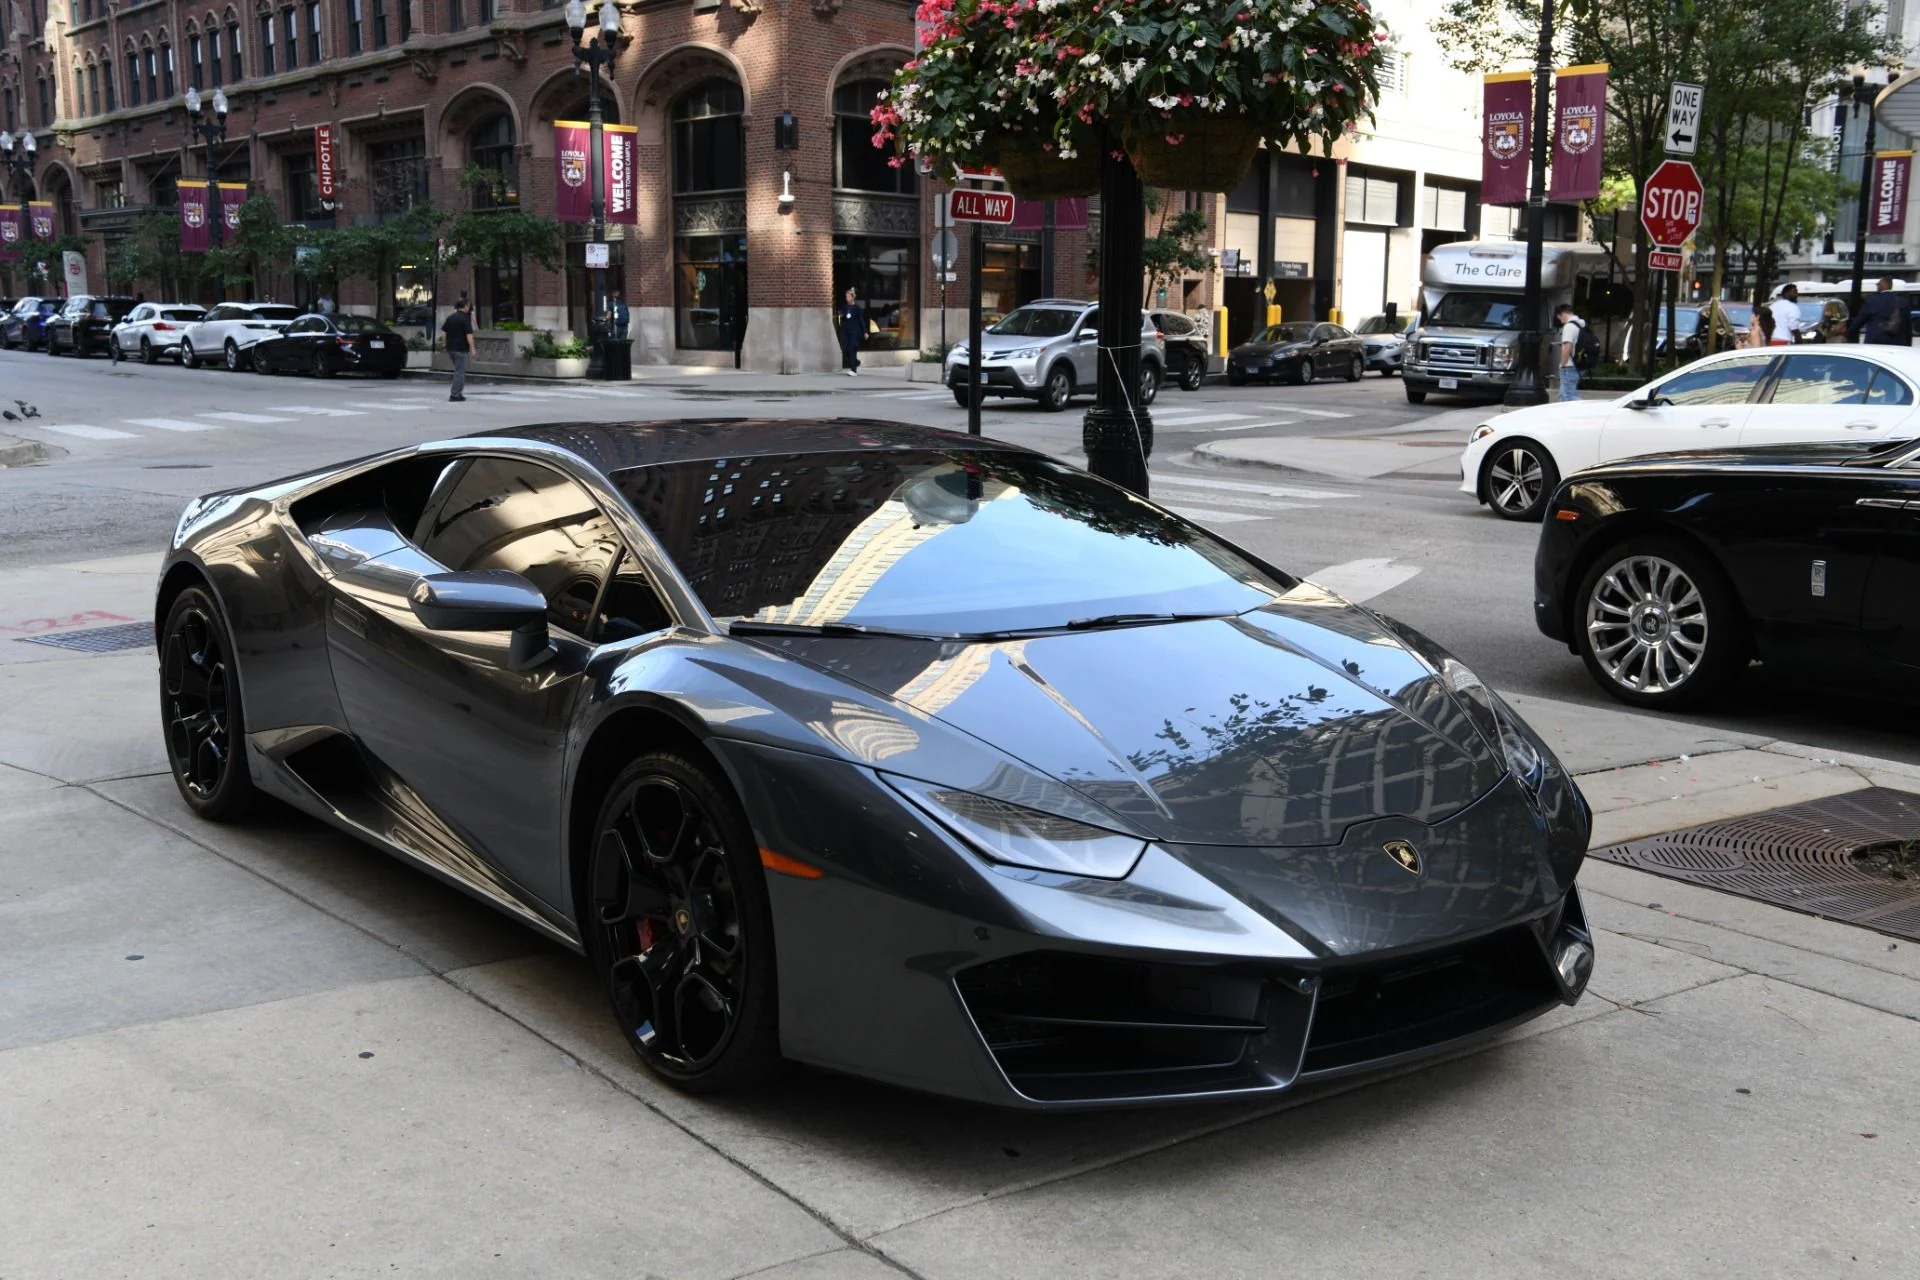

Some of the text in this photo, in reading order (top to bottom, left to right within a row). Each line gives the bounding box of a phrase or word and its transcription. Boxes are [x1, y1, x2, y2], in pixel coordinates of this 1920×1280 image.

[1674, 89, 1699, 108] ONE
[1489, 111, 1524, 122] LOYOLA
[1562, 105, 1597, 115] LOYOLA
[1671, 108, 1697, 127] WAY
[319, 129, 333, 194] CHIPOTLE
[610, 134, 625, 214] WELCOME
[1877, 160, 1897, 227] WELCOME
[957, 195, 1008, 217] ALL WAY
[1646, 186, 1699, 221] STOP
[1455, 262, 1522, 277] The Clare
[1651, 253, 1681, 268] ALL WAY
